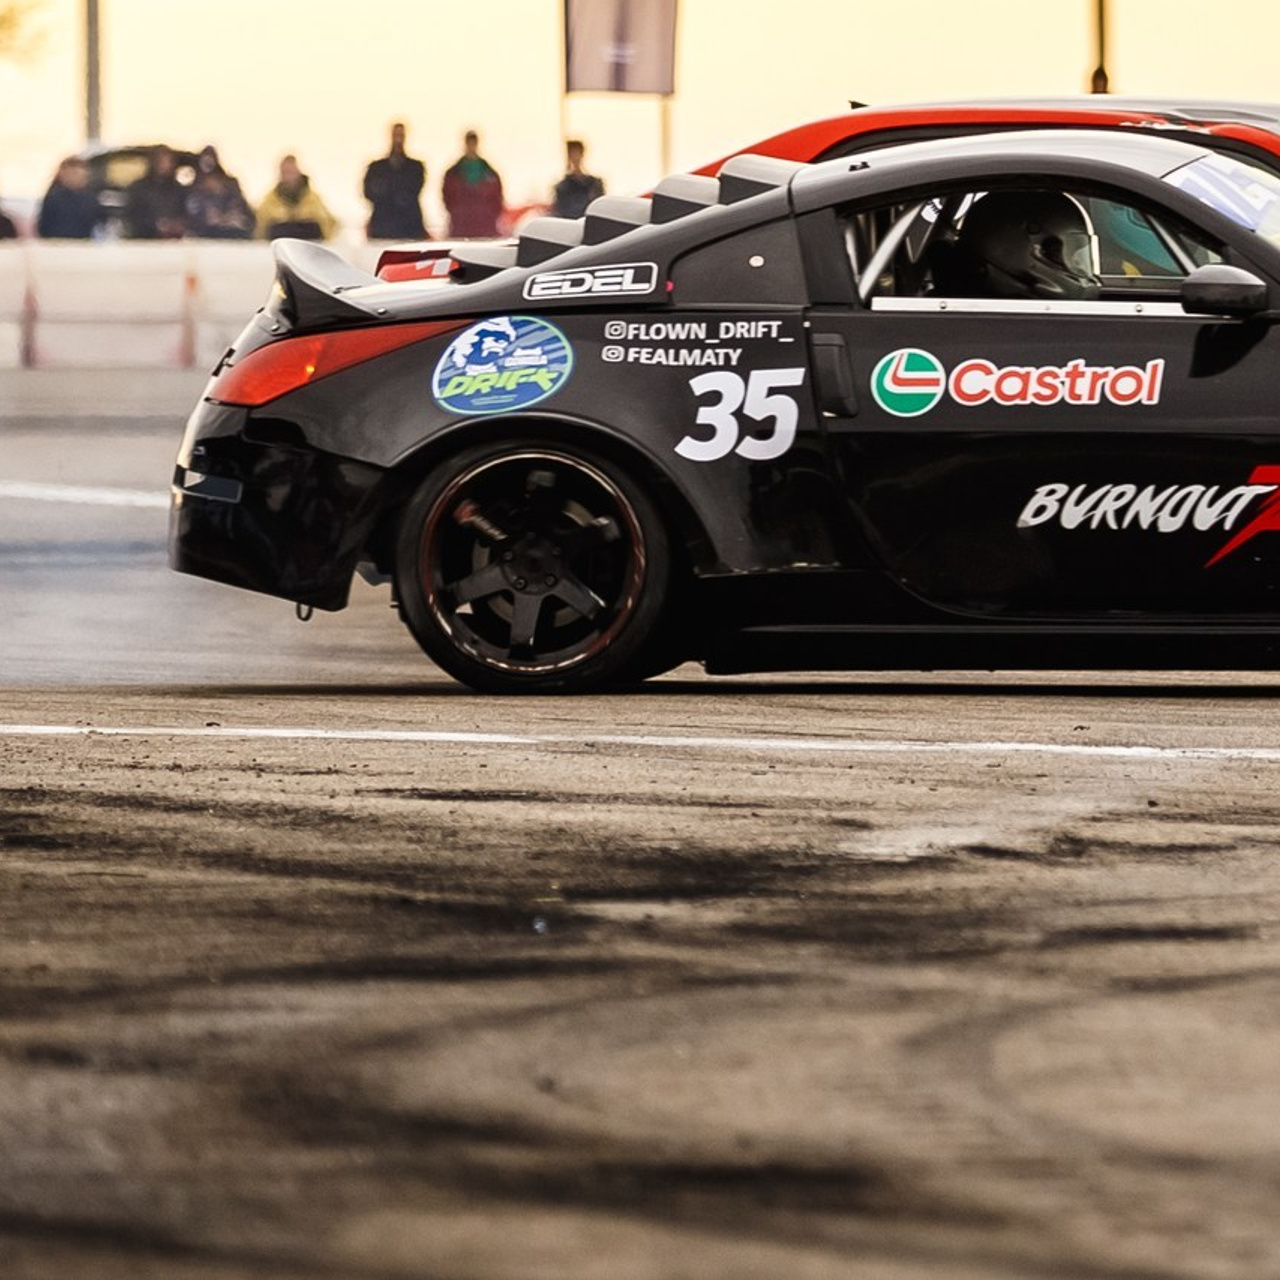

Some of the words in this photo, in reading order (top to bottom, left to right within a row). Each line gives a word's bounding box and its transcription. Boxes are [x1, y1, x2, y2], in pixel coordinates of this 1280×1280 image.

[529, 269, 652, 297] EDEL
[627, 348, 743, 367] FEALMATY
[441, 368, 558, 399] DRIFT
[949, 358, 1165, 406] Castrol
[674, 367, 806, 462] 35
